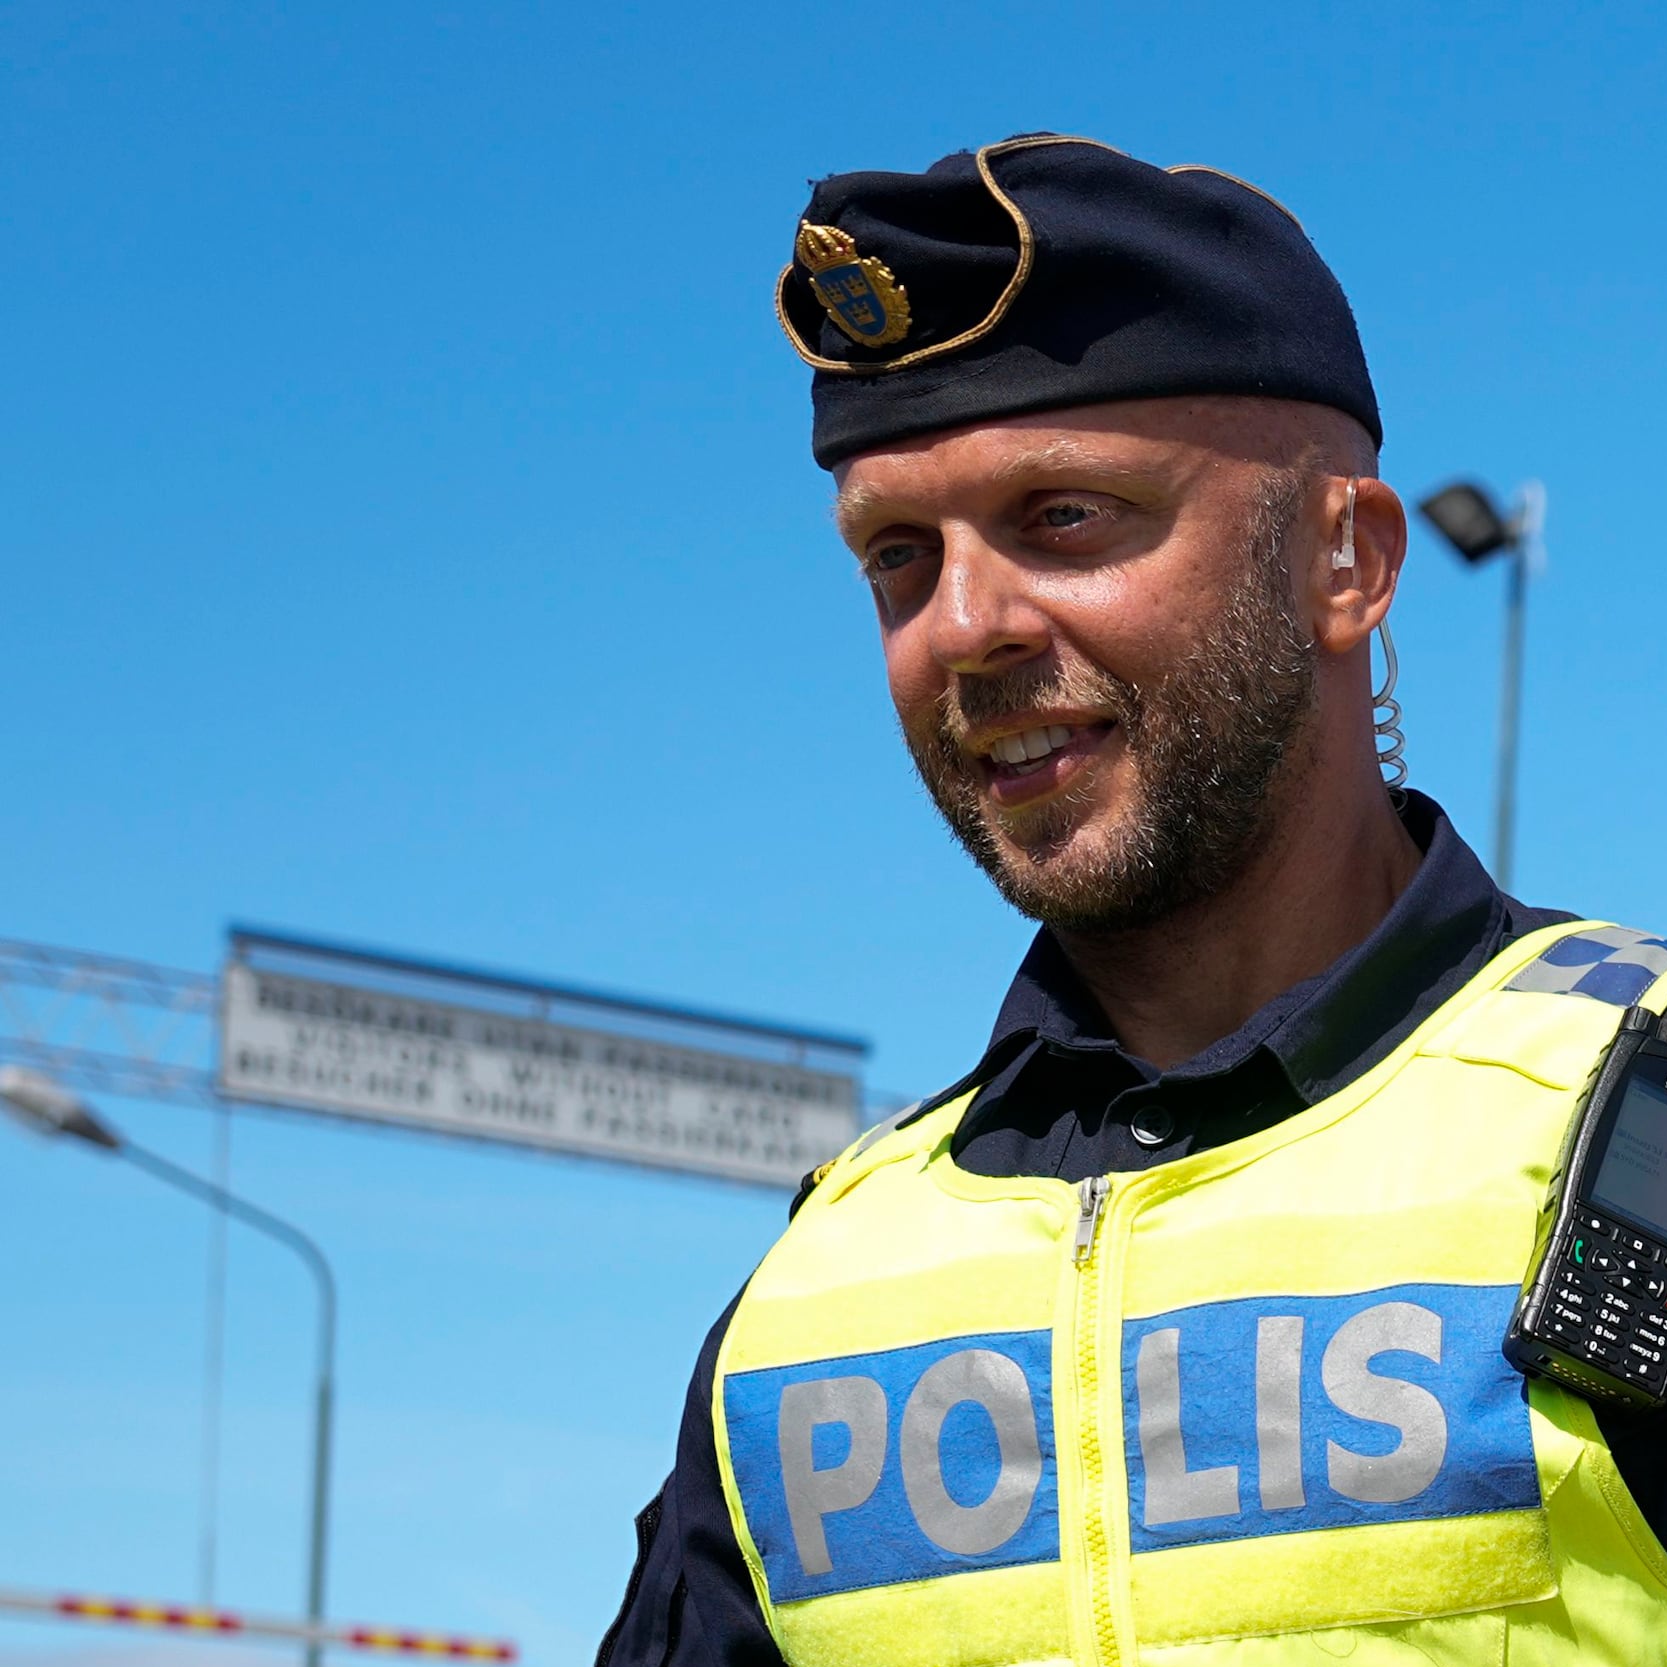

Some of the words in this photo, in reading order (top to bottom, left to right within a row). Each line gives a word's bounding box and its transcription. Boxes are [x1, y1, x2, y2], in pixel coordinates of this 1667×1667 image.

[1560, 1289, 1569, 1299] 4
[1605, 1293, 1614, 1304] 2
[1555, 1304, 1563, 1314] 7
[1600, 1309, 1608, 1319] 5
[1595, 1325, 1603, 1335] 8
[1657, 1336, 1666, 1346] 6
[1652, 1351, 1660, 1362] 9
[779, 1301, 1447, 1575] POLIS
